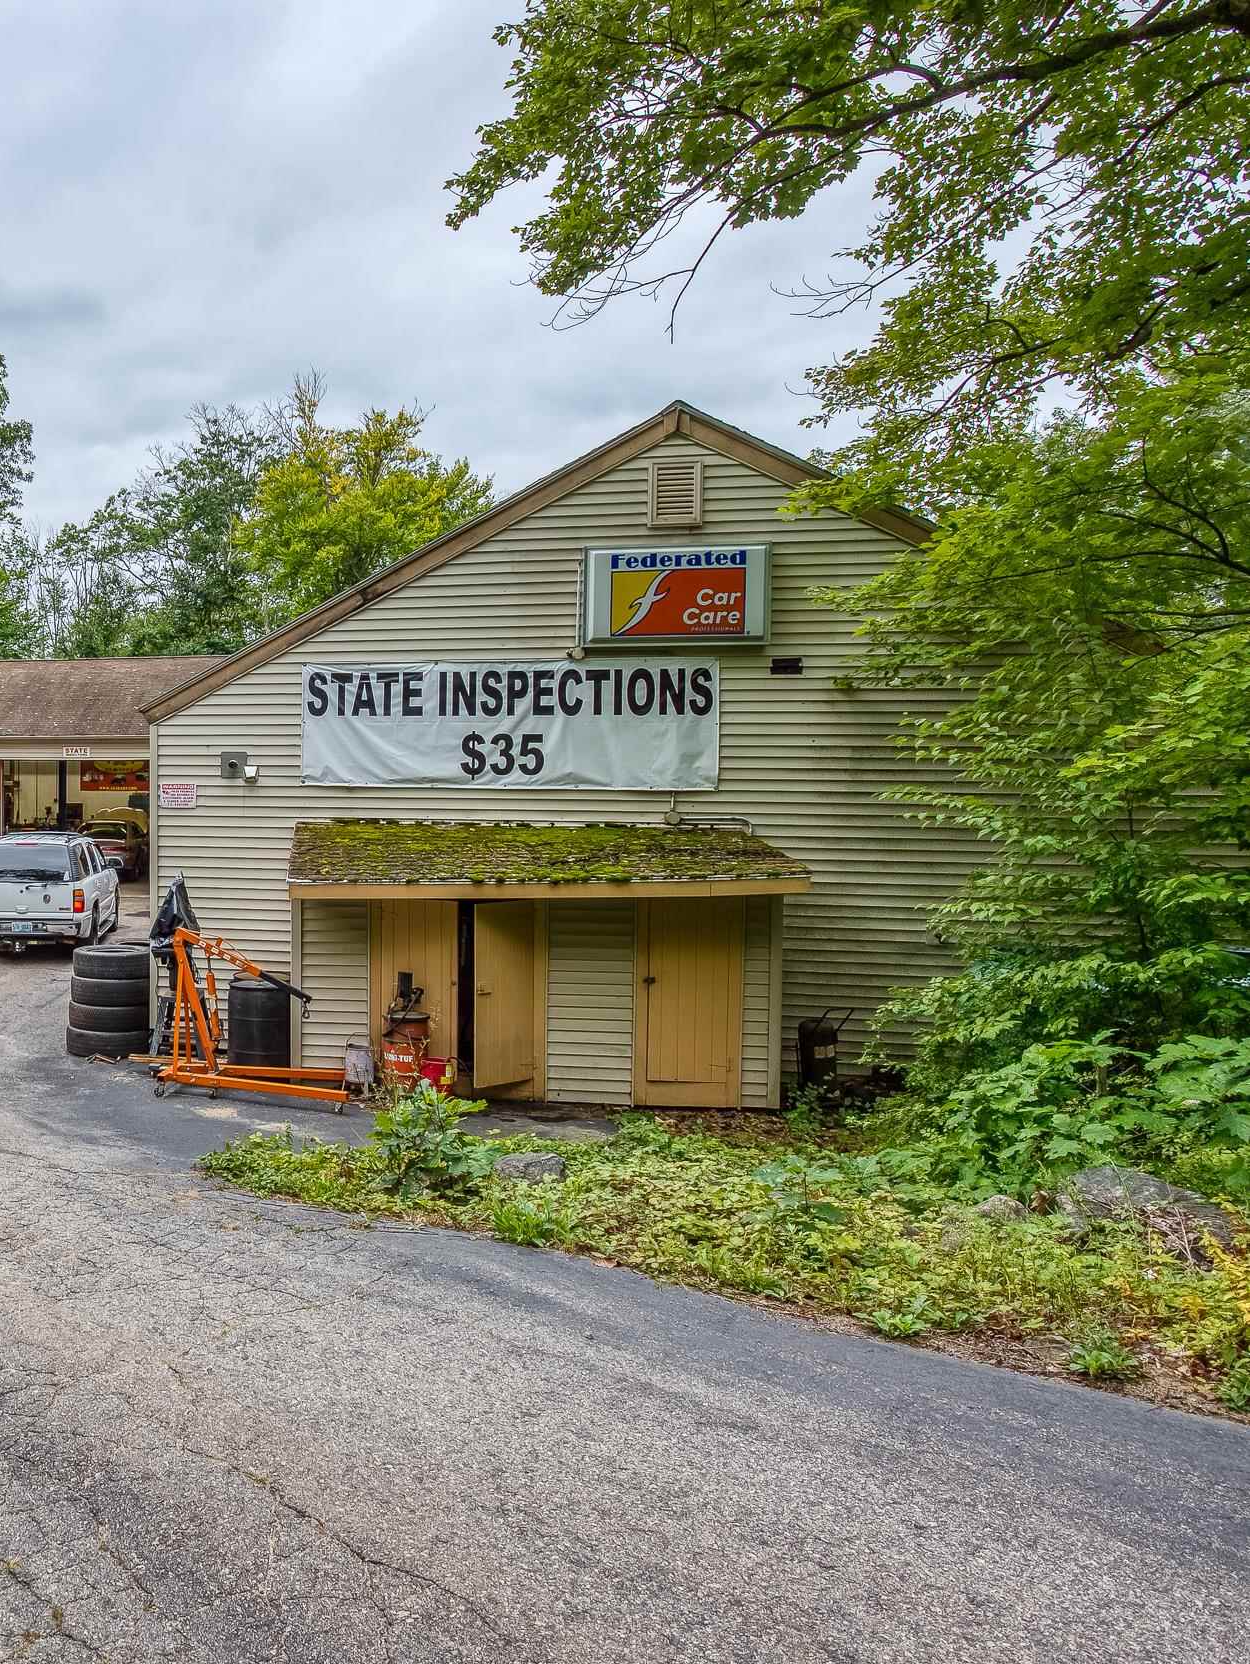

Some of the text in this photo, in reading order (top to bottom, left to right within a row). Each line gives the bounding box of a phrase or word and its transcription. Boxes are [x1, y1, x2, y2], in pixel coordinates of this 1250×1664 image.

[611, 550, 747, 569] Federated
[696, 588, 741, 606] Car
[682, 607, 741, 625] Care
[306, 667, 714, 717] STATE INSPECTIONS
[460, 731, 545, 780] $35
